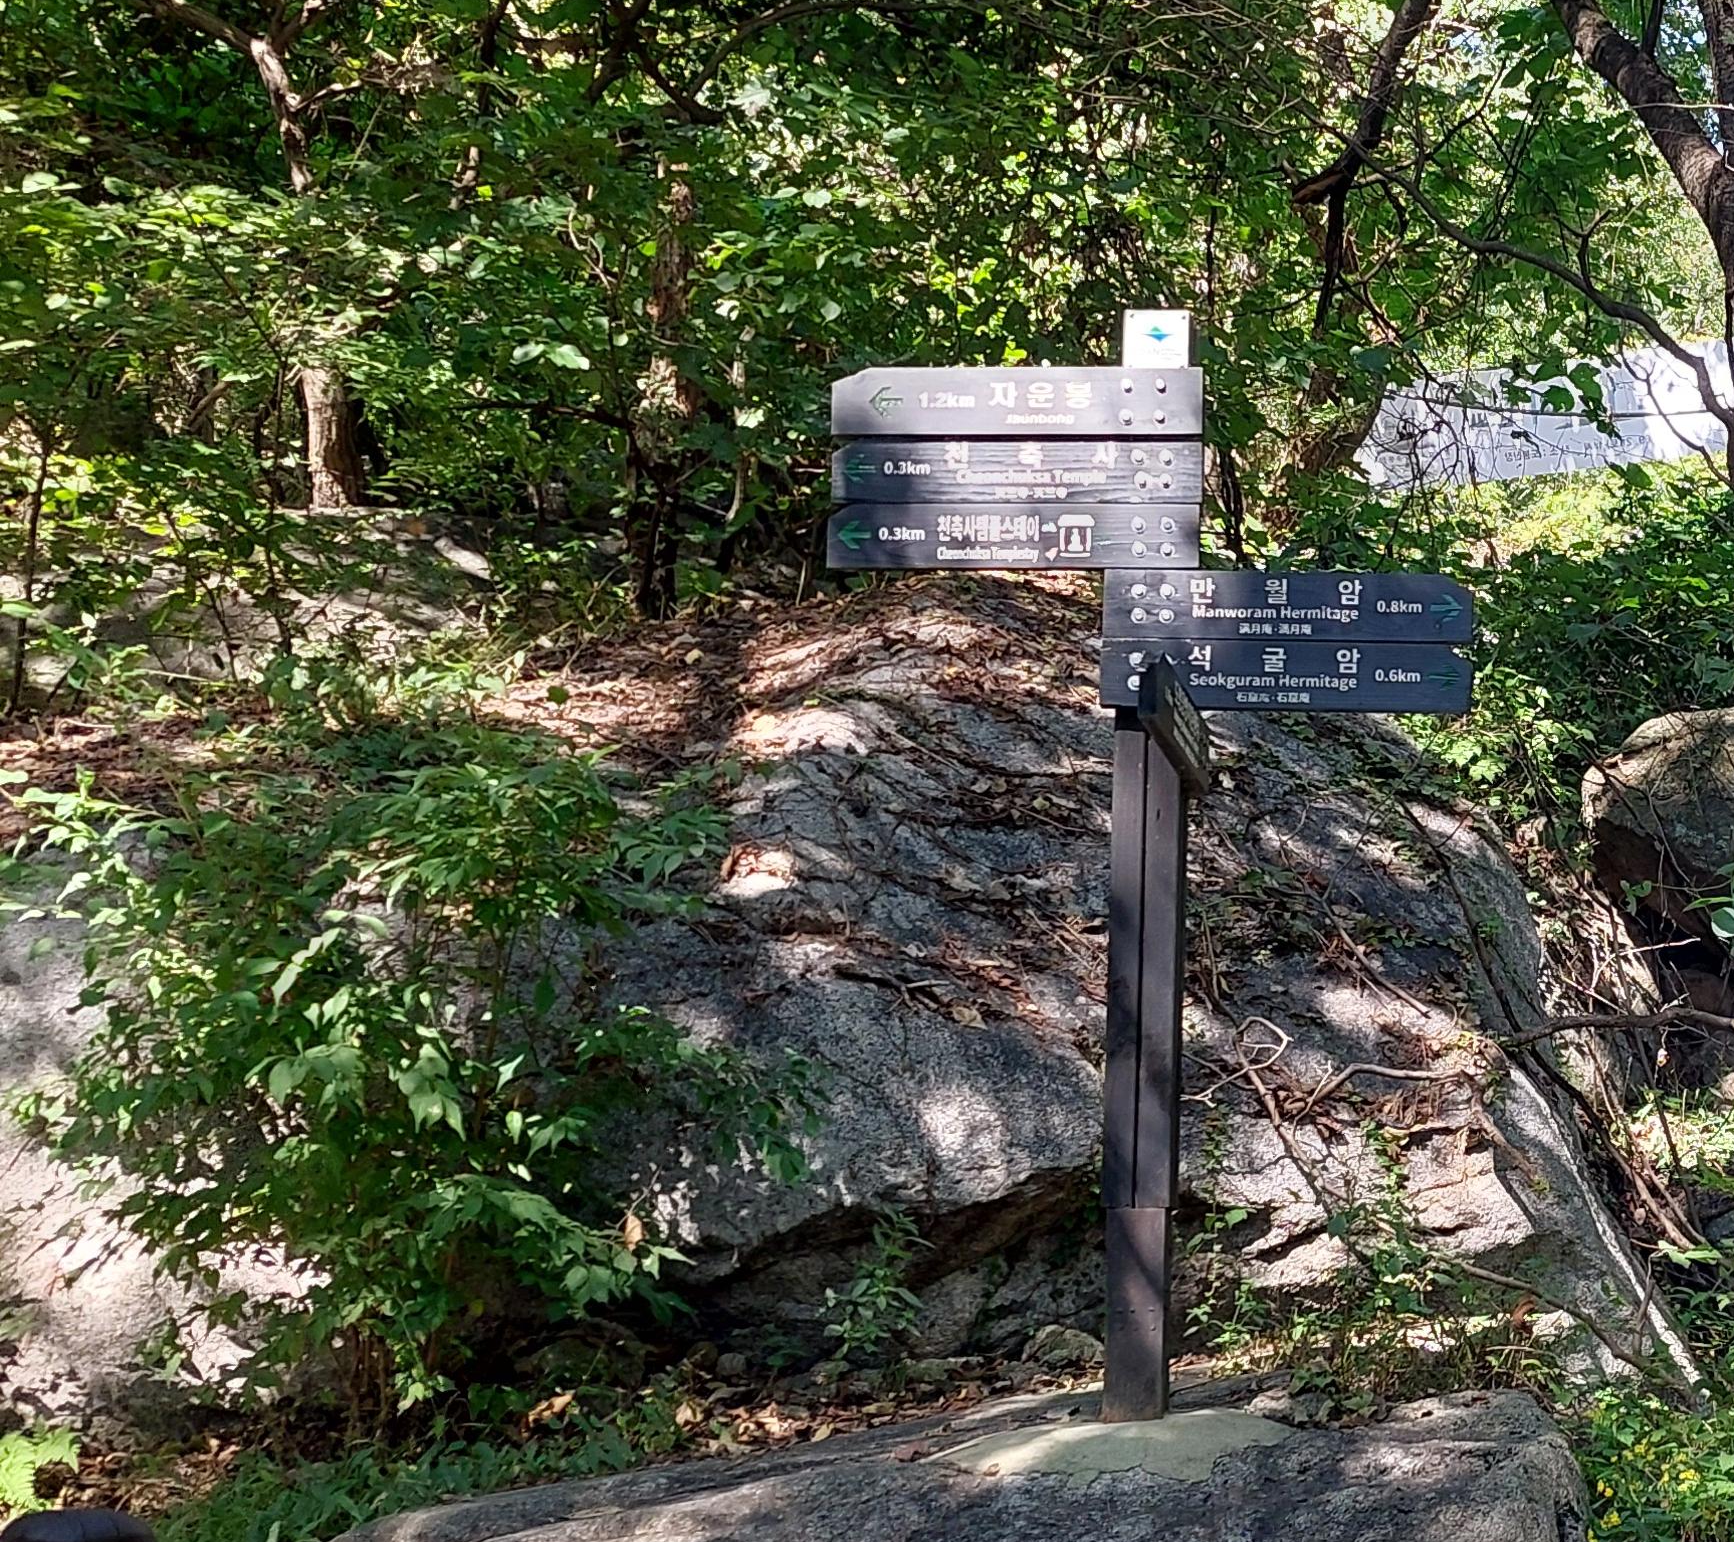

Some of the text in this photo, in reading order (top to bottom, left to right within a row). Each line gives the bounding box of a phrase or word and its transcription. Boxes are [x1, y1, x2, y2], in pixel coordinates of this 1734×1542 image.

[918, 381, 1093, 410] 1.2km 자운봉
[883, 462, 931, 476] 0.3km
[878, 527, 926, 541] 0.3km
[1189, 576, 1423, 614] 만월암 0.8km
[1192, 605, 1360, 623] Manworam Hermitage
[1188, 644, 1422, 683] 석굴암 0.6km
[1189, 672, 1358, 691] Seokguram Hermitage
